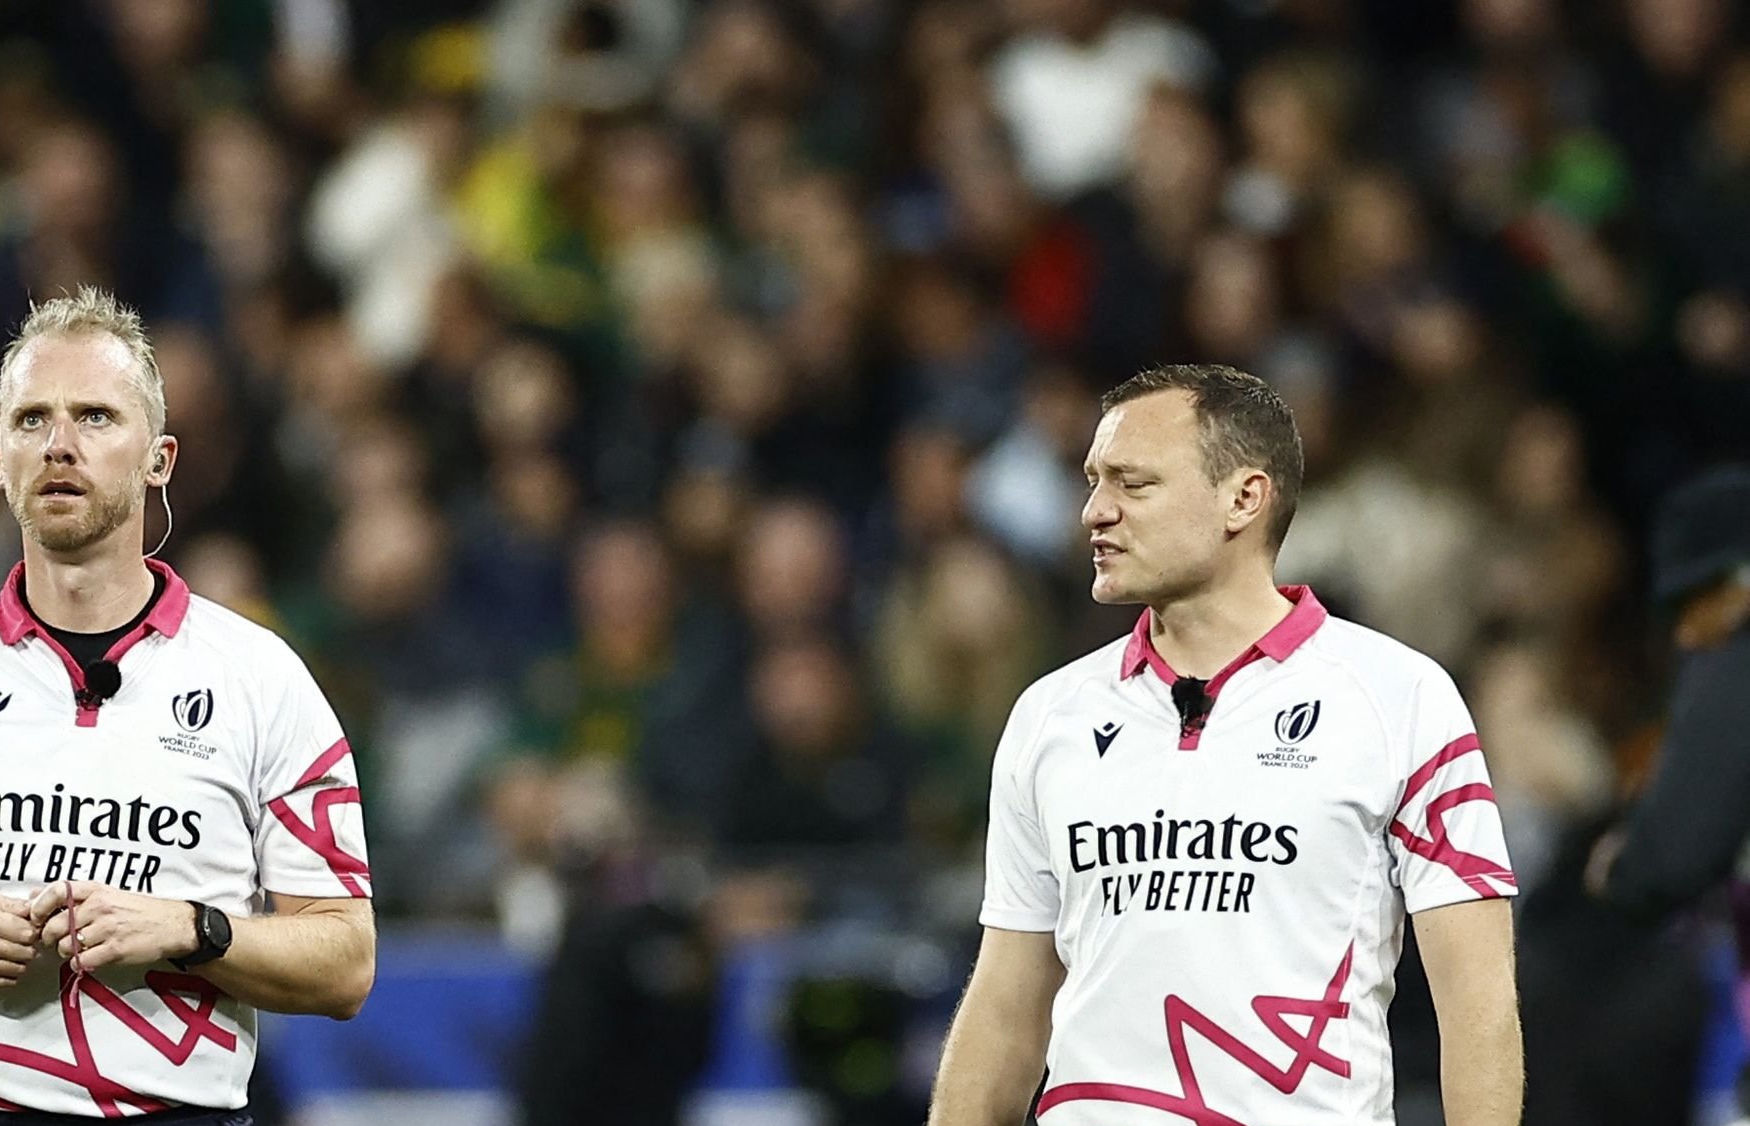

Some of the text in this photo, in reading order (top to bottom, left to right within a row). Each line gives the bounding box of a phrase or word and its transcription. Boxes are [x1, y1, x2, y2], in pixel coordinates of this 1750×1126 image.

[158, 736, 217, 754] WORLD CUP
[164, 745, 210, 760] FRANCE 2023
[1257, 753, 1318, 763] WORLD CUP
[1067, 809, 1298, 873] Emirates
[44, 844, 161, 893] BETTER
[1101, 870, 1255, 917] FLY BETTER
